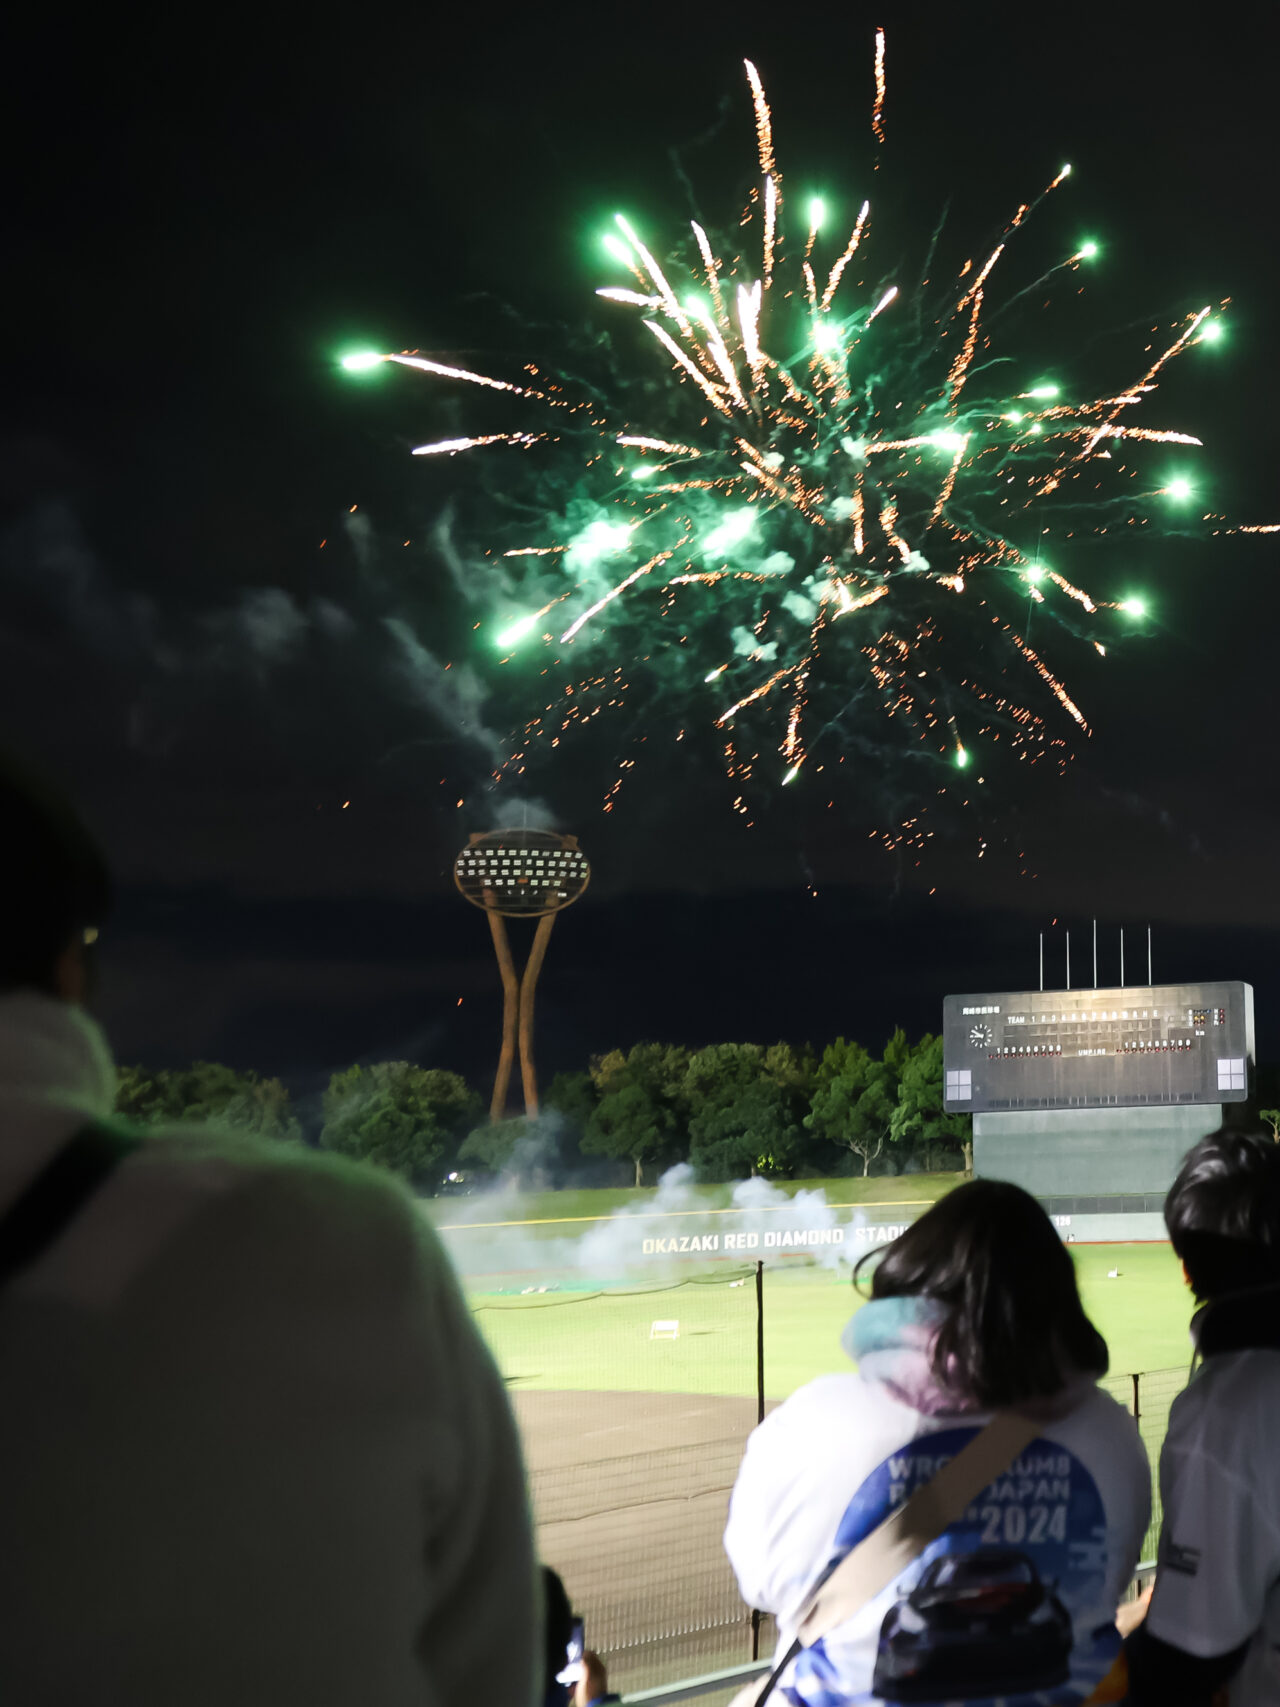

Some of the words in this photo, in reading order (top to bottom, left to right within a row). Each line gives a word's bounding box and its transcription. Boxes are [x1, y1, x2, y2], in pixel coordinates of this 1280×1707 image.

[1007, 1015, 1025, 1025] TEAM
[642, 1234, 719, 1254] OKAZAKI
[724, 1232, 759, 1249] RED
[764, 1228, 845, 1248] DIAMOND
[855, 1225, 909, 1243] STADI
[980, 1504, 1068, 1544] 2024
